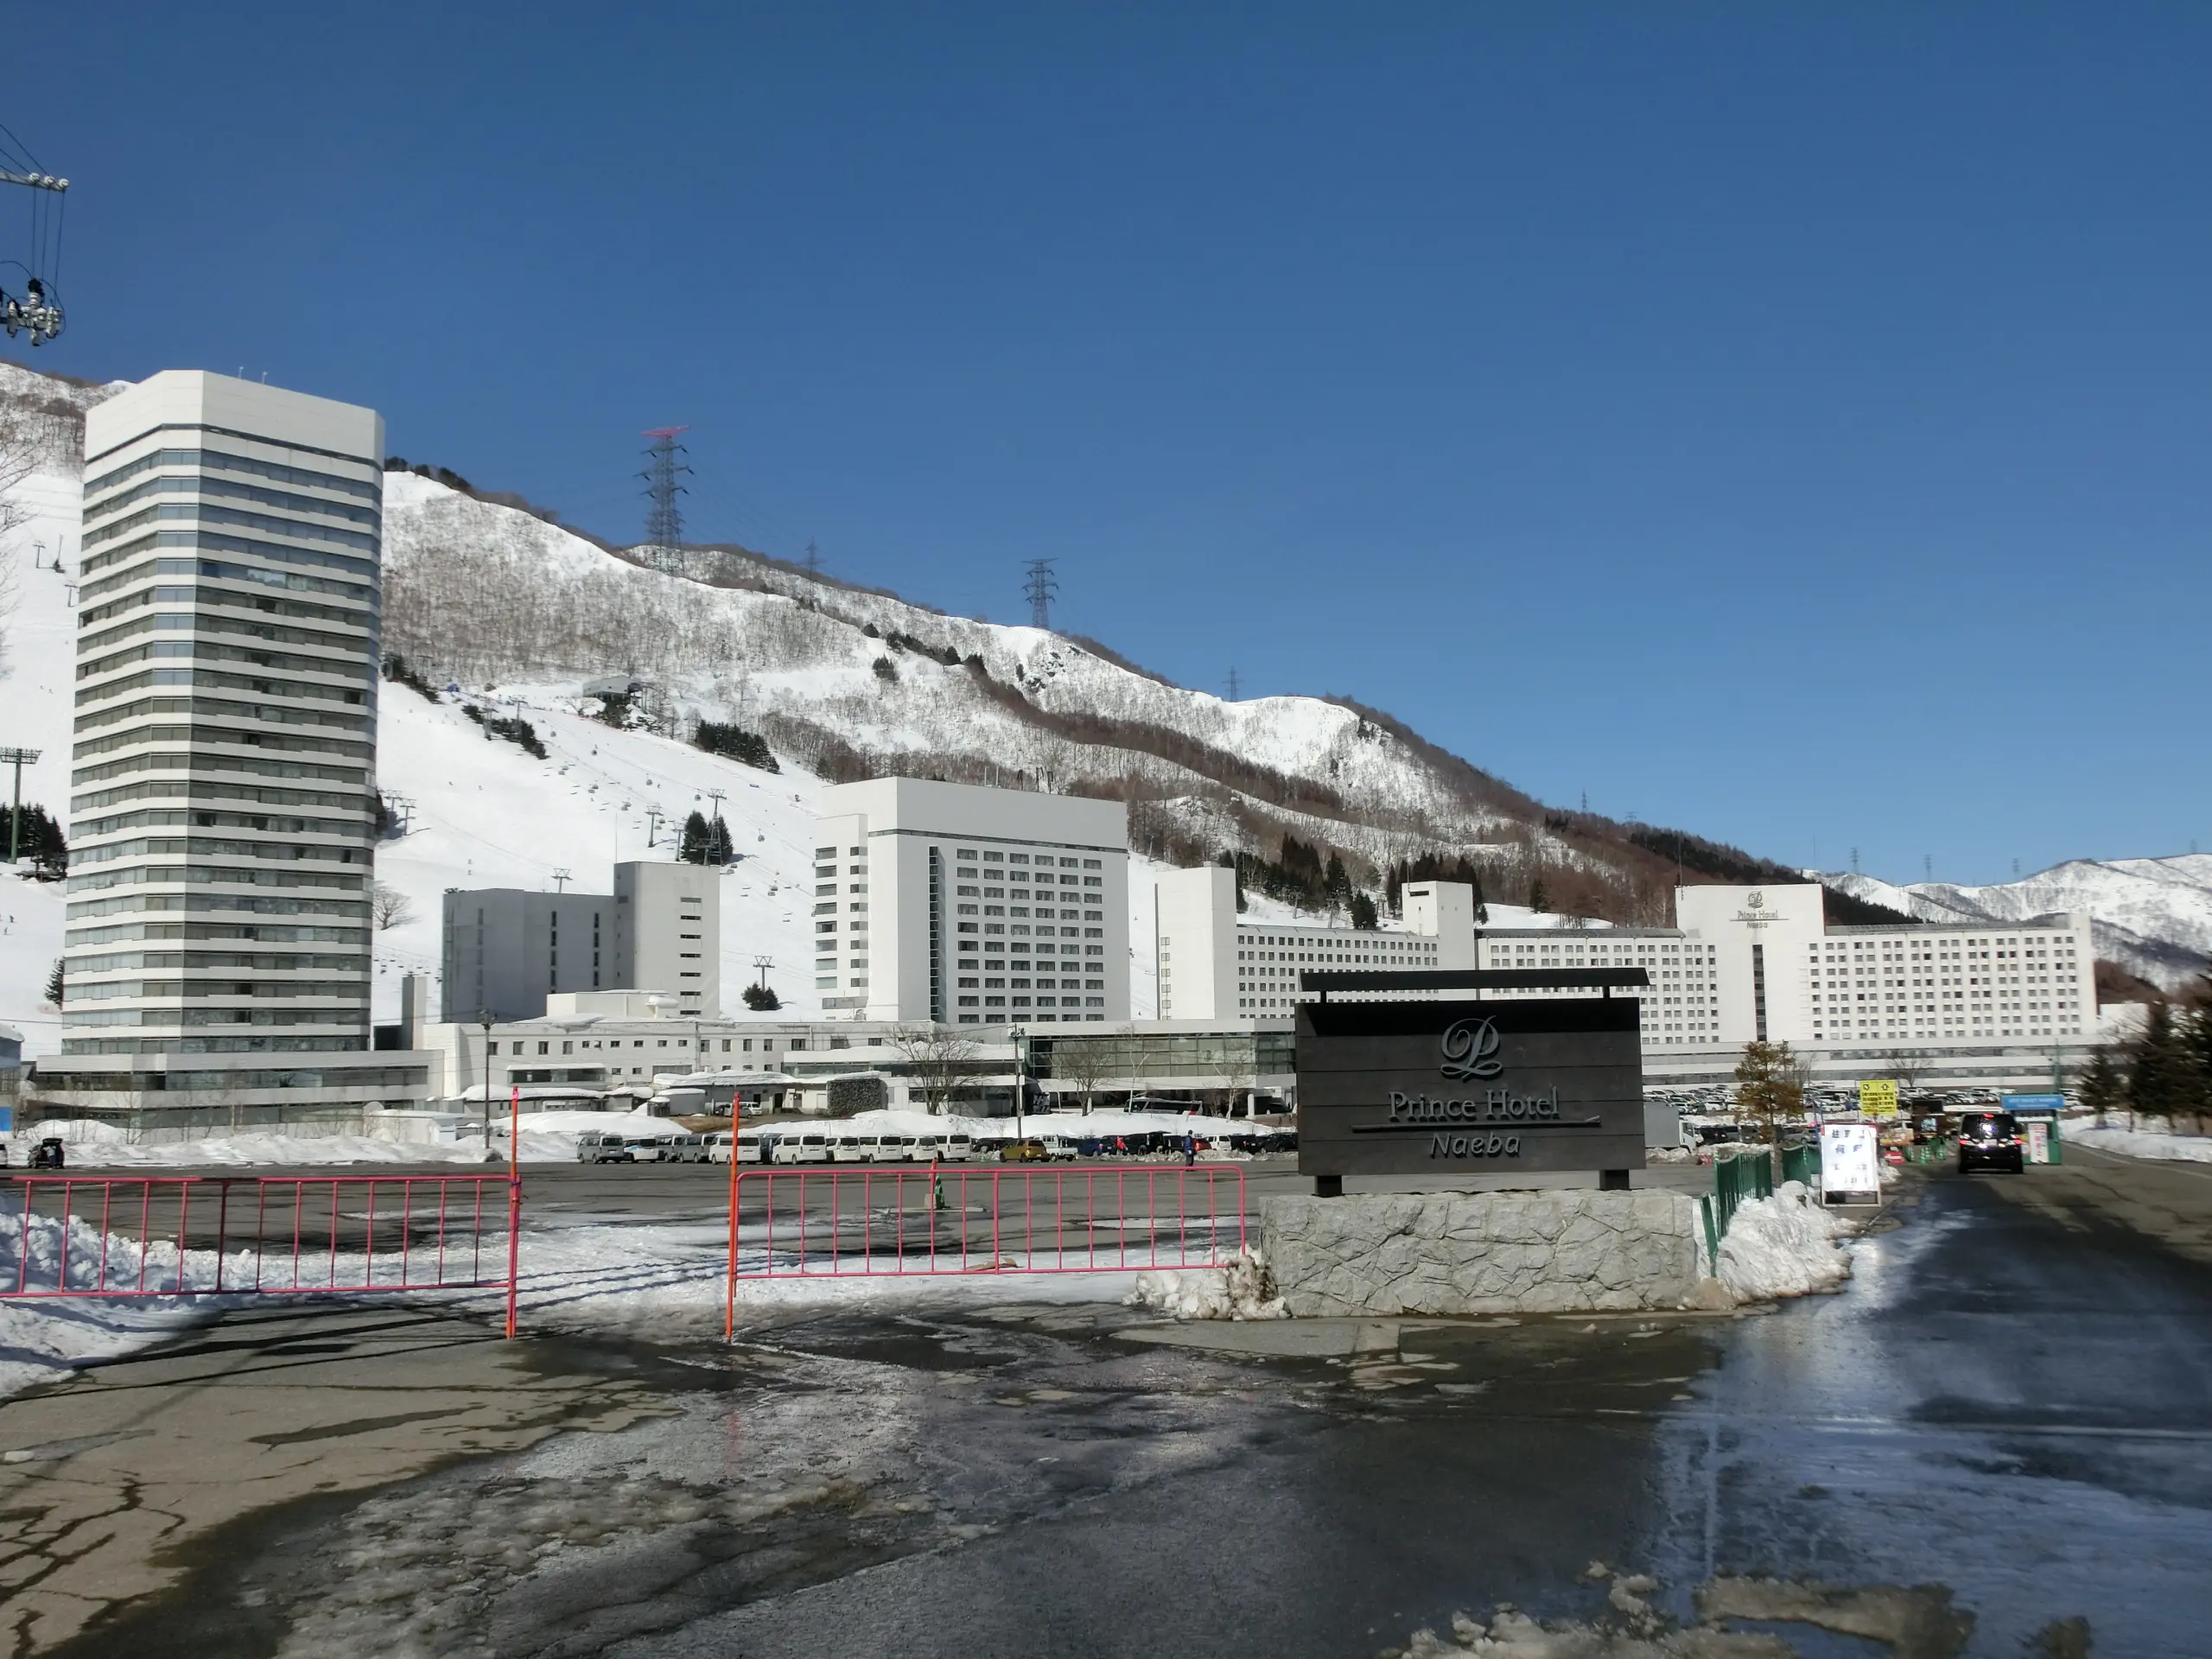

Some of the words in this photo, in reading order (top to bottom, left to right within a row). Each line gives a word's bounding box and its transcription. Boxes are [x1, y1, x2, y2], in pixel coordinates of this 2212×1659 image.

[1388, 1090, 1477, 1122] Prince
[1485, 1086, 1560, 1120] Hotel
[1430, 1131, 1521, 1159] Naeba
